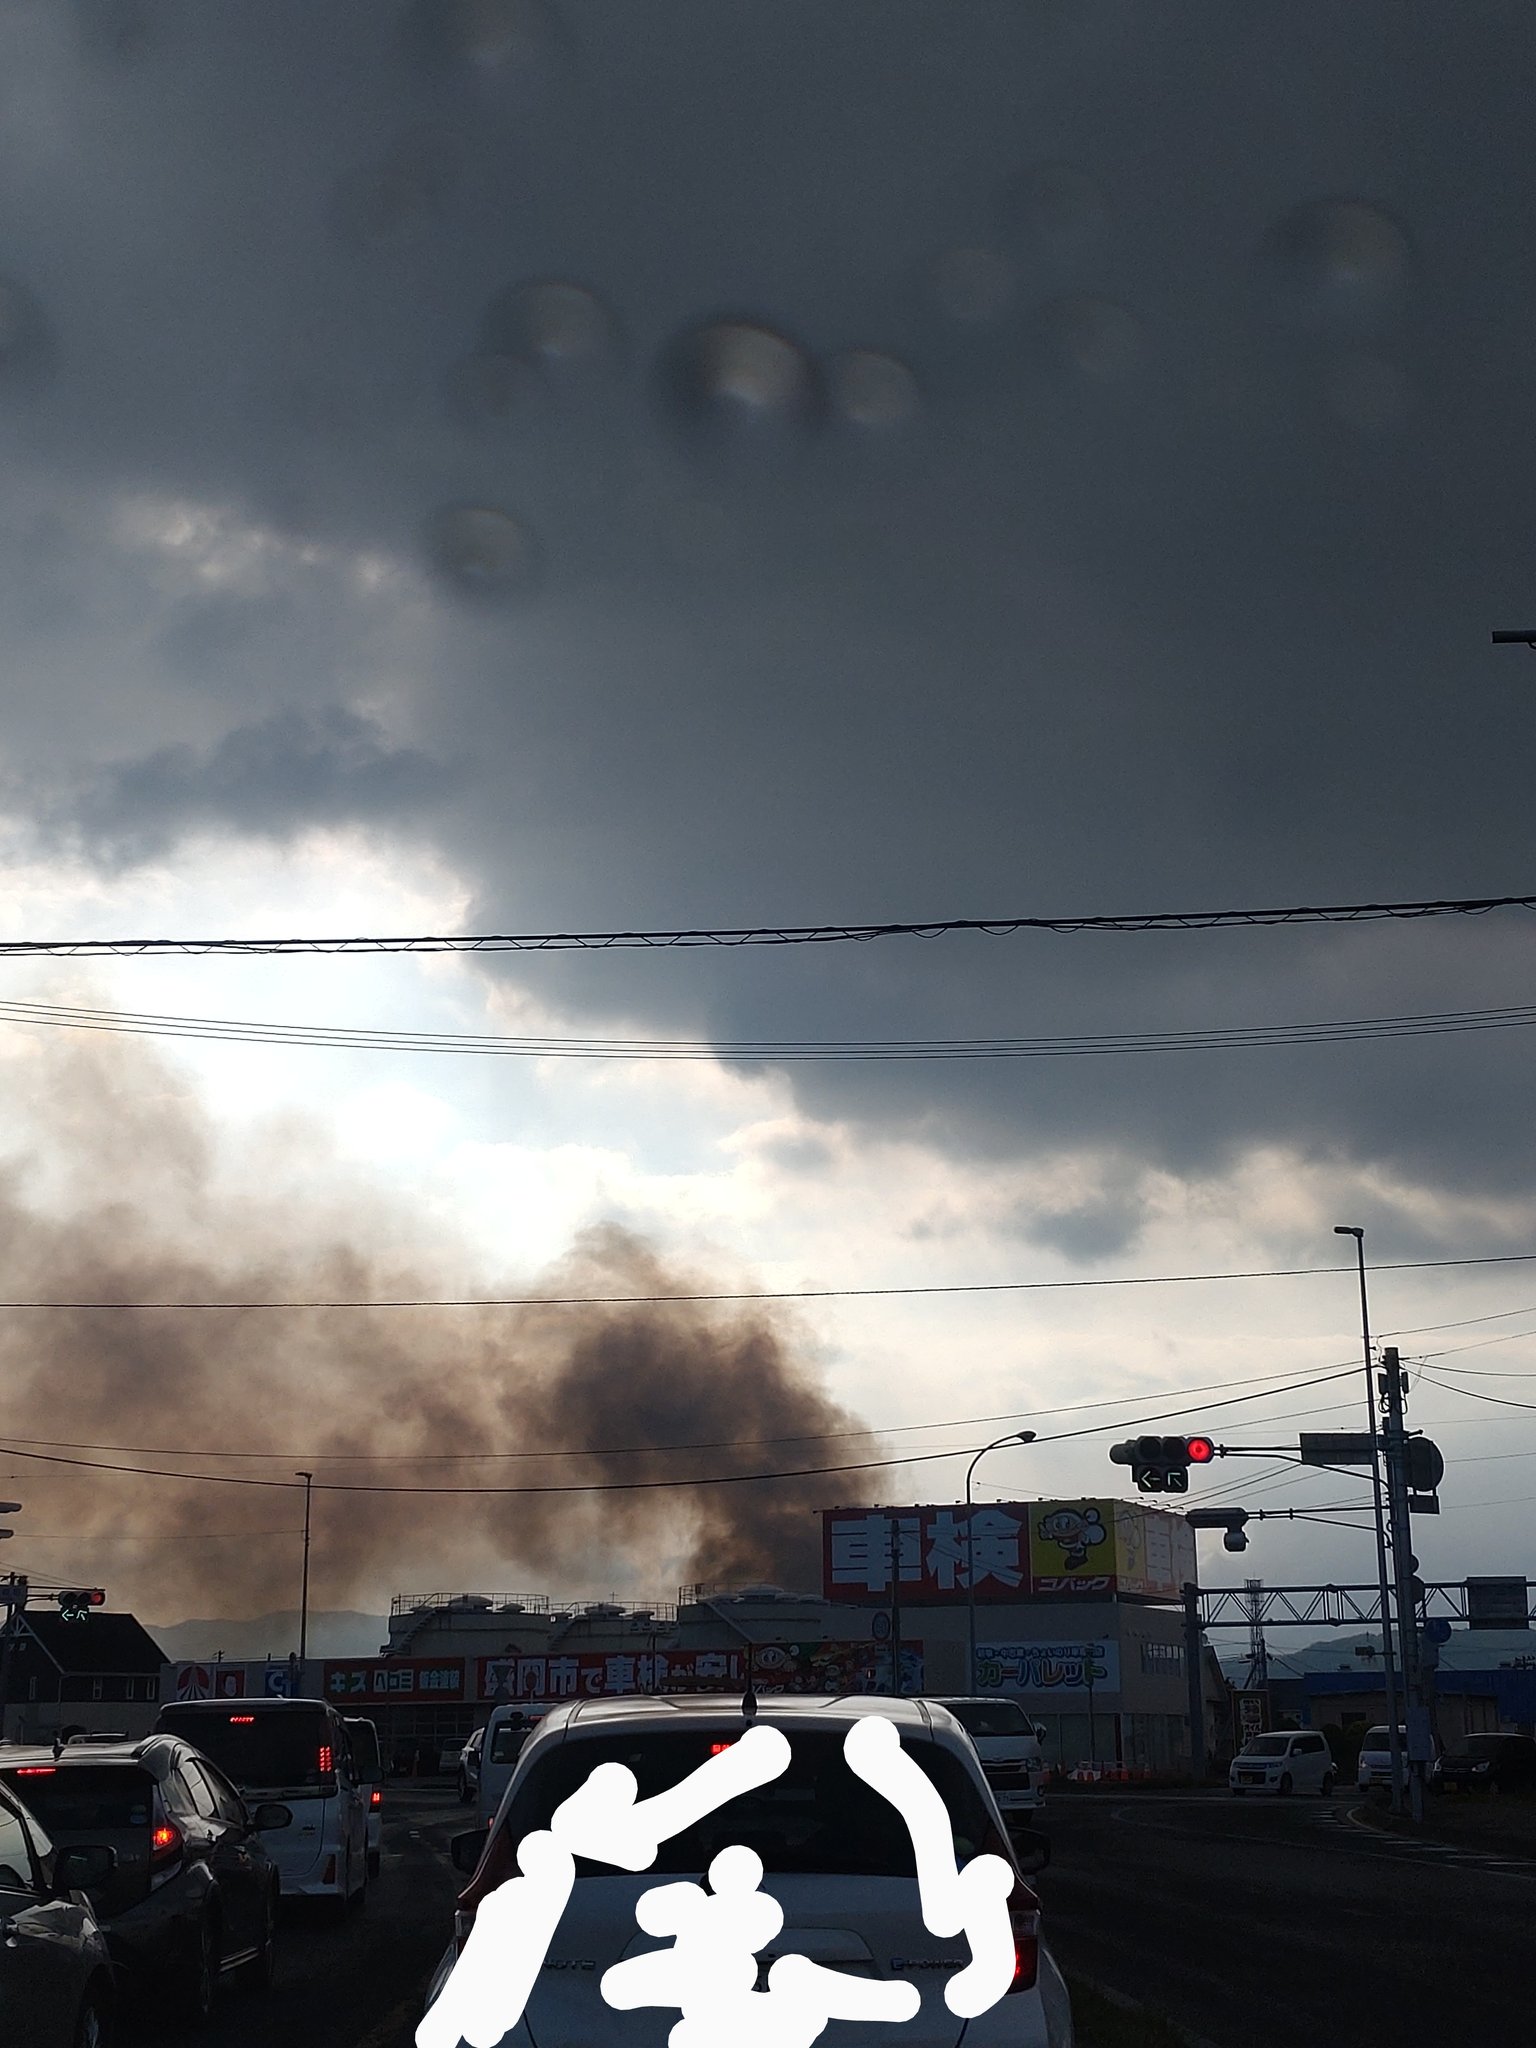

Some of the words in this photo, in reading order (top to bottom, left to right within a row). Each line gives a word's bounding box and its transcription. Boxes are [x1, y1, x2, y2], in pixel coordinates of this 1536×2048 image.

[831, 1508, 1024, 1592] 車検
[1039, 1576, 1110, 1592] コバック
[976, 1657, 1108, 1688] カーパレット
